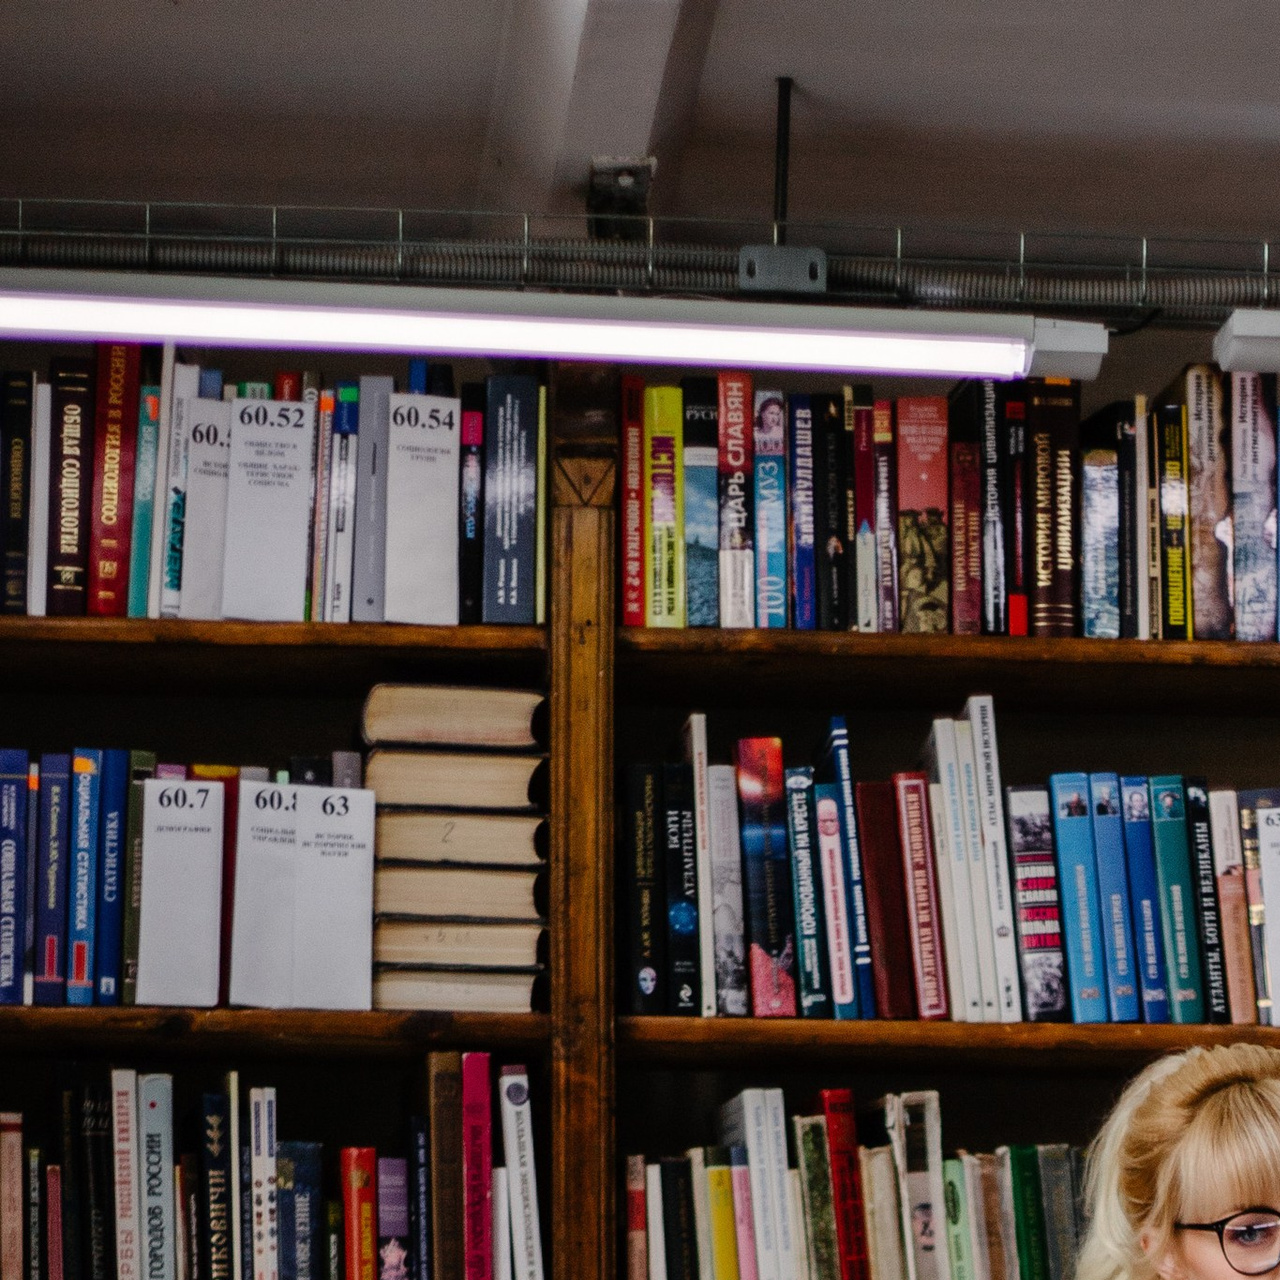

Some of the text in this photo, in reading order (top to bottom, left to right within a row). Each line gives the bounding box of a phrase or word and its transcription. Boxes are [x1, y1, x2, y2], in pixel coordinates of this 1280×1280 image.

[109, 346, 125, 404] РОССИИ
[239, 404, 305, 429] 60.52
[392, 405, 455, 430] 60.54
[726, 382, 748, 527] ЦАРЬ СЛАВЯН
[59, 404, 81, 554] ОБЩАЯ СОЦИОЛОГИЯ
[101, 424, 121, 525] СОЦИОЛОГИЯ
[757, 461, 779, 504] МУЗ
[985, 469, 999, 521] ИСТОРИЯ
[1031, 432, 1053, 587] ИСТОРИЯ МИРОВОЙ
[1056, 449, 1073, 571] ЦИВИЛИЗАЦИИ
[759, 576, 784, 616] 100
[1168, 546, 1185, 625] ПОКУШЕНИЕ
[158, 789, 209, 808] 60.7
[979, 704, 997, 827] АТЛАС МИРОВОЙ ИСТОРИИ
[322, 795, 349, 816] 63
[667, 810, 679, 850] БОГИ
[104, 811, 118, 902] СТАТИСТИКА
[681, 809, 696, 899] АТЛАНТИДЫ
[792, 792, 817, 936] КОРОНОВАННЫЙ НА КРЕСТЕ
[907, 794, 939, 1005] ПОПУЛЯРНАЯ ИСТОРИЯ ЭКОНОМИКИ
[1196, 821, 1226, 1013] АТЛАНТЫ, БОГИ И ВЕЛИКАНЫ
[145, 1133, 162, 1197] РОССИИ
[145, 1205, 165, 1280] ГОРОДОВ
